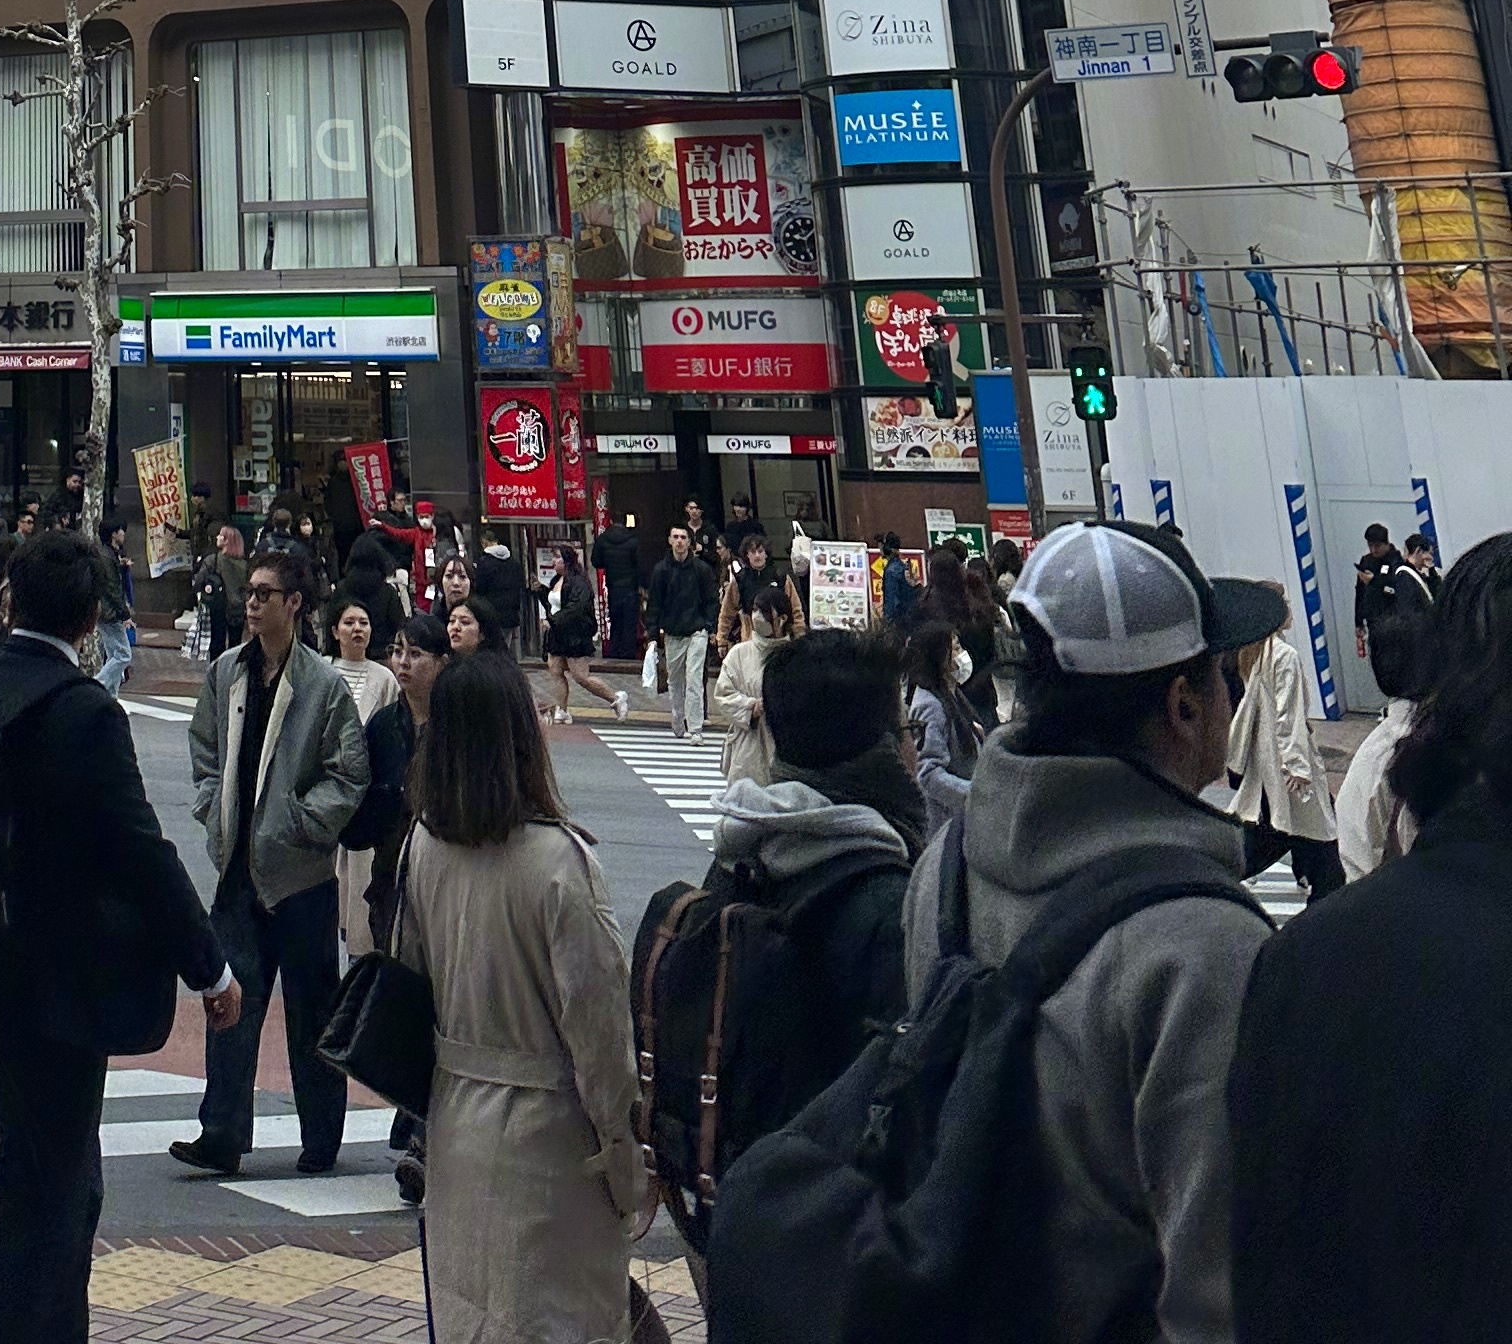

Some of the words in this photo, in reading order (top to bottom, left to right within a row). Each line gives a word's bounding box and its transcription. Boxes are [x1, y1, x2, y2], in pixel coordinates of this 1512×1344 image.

[870, 14, 932, 35] Zina
[871, 31, 934, 46] SHIBUYA
[1054, 29, 1166, 60] 神南一丁目
[497, 57, 516, 71] 5F
[611, 59, 678, 77] GOALD
[1077, 59, 1132, 77] Jinnan
[1142, 55, 1152, 72] 1
[844, 128, 950, 146] PLATINUM
[683, 143, 757, 187] 高価
[688, 185, 761, 227] 買取
[683, 236, 775, 262] おたからや
[883, 246, 930, 259] GOALD
[707, 309, 778, 332] MUFG
[219, 324, 337, 352] FamilyMart
[26, 355, 48, 368] Cash
[48, 355, 78, 368] Corner
[675, 357, 793, 379] 三菱UFJ銀行
[490, 408, 546, 462] 一蘭
[742, 439, 772, 450] MUFG
[1042, 429, 1080, 445] Zina
[1061, 489, 1077, 501] 6F
